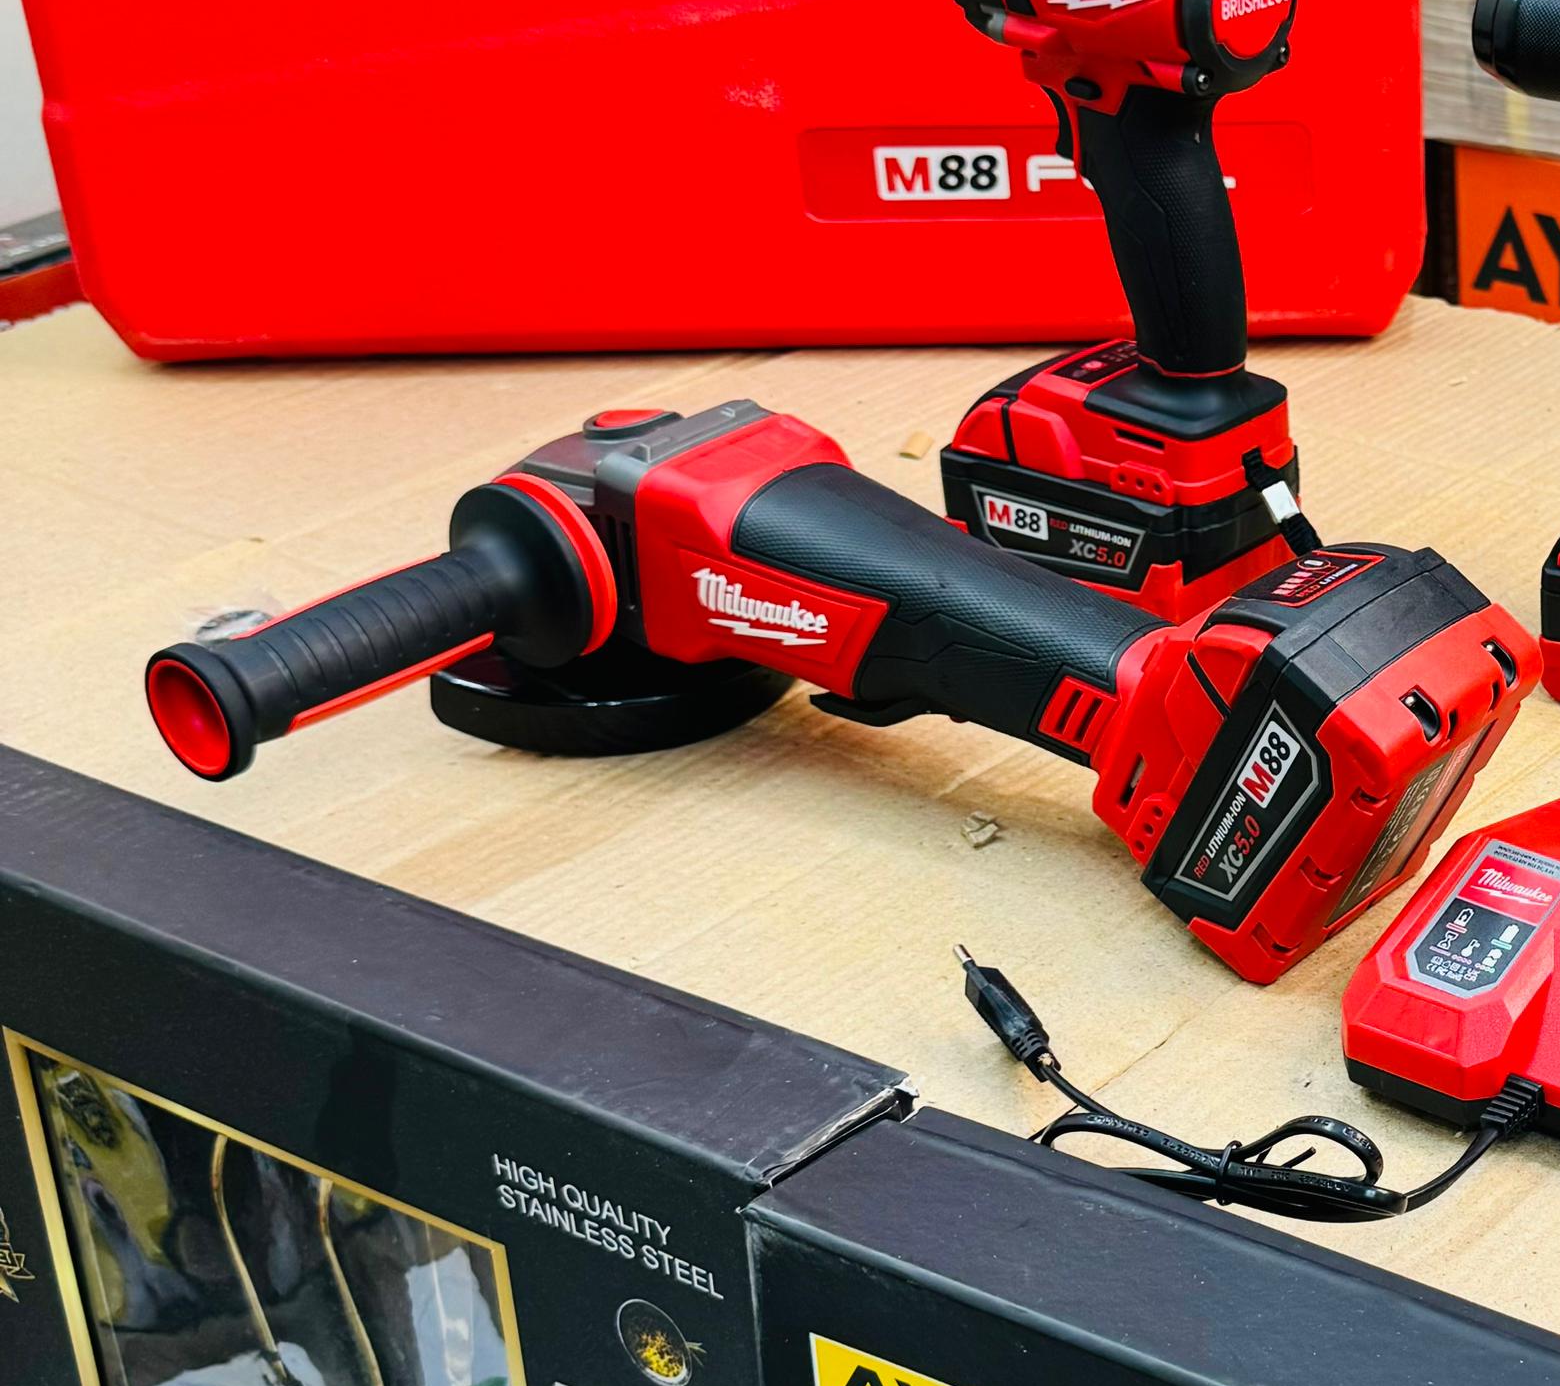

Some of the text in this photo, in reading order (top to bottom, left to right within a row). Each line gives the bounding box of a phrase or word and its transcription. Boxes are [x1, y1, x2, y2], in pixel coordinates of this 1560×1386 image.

[884, 154, 998, 192] M88
[988, 499, 1042, 533] M88
[1070, 538, 1126, 568] XC5.0
[691, 567, 829, 634] Milwaukee
[1193, 731, 1292, 879] RED LITHIUM-ION M88
[1222, 814, 1263, 884] XC5.0
[1477, 867, 1553, 902] Milwaukee
[491, 1153, 671, 1246] HIGH QUALITY
[497, 1184, 724, 1301] STAINLESS STEEL
